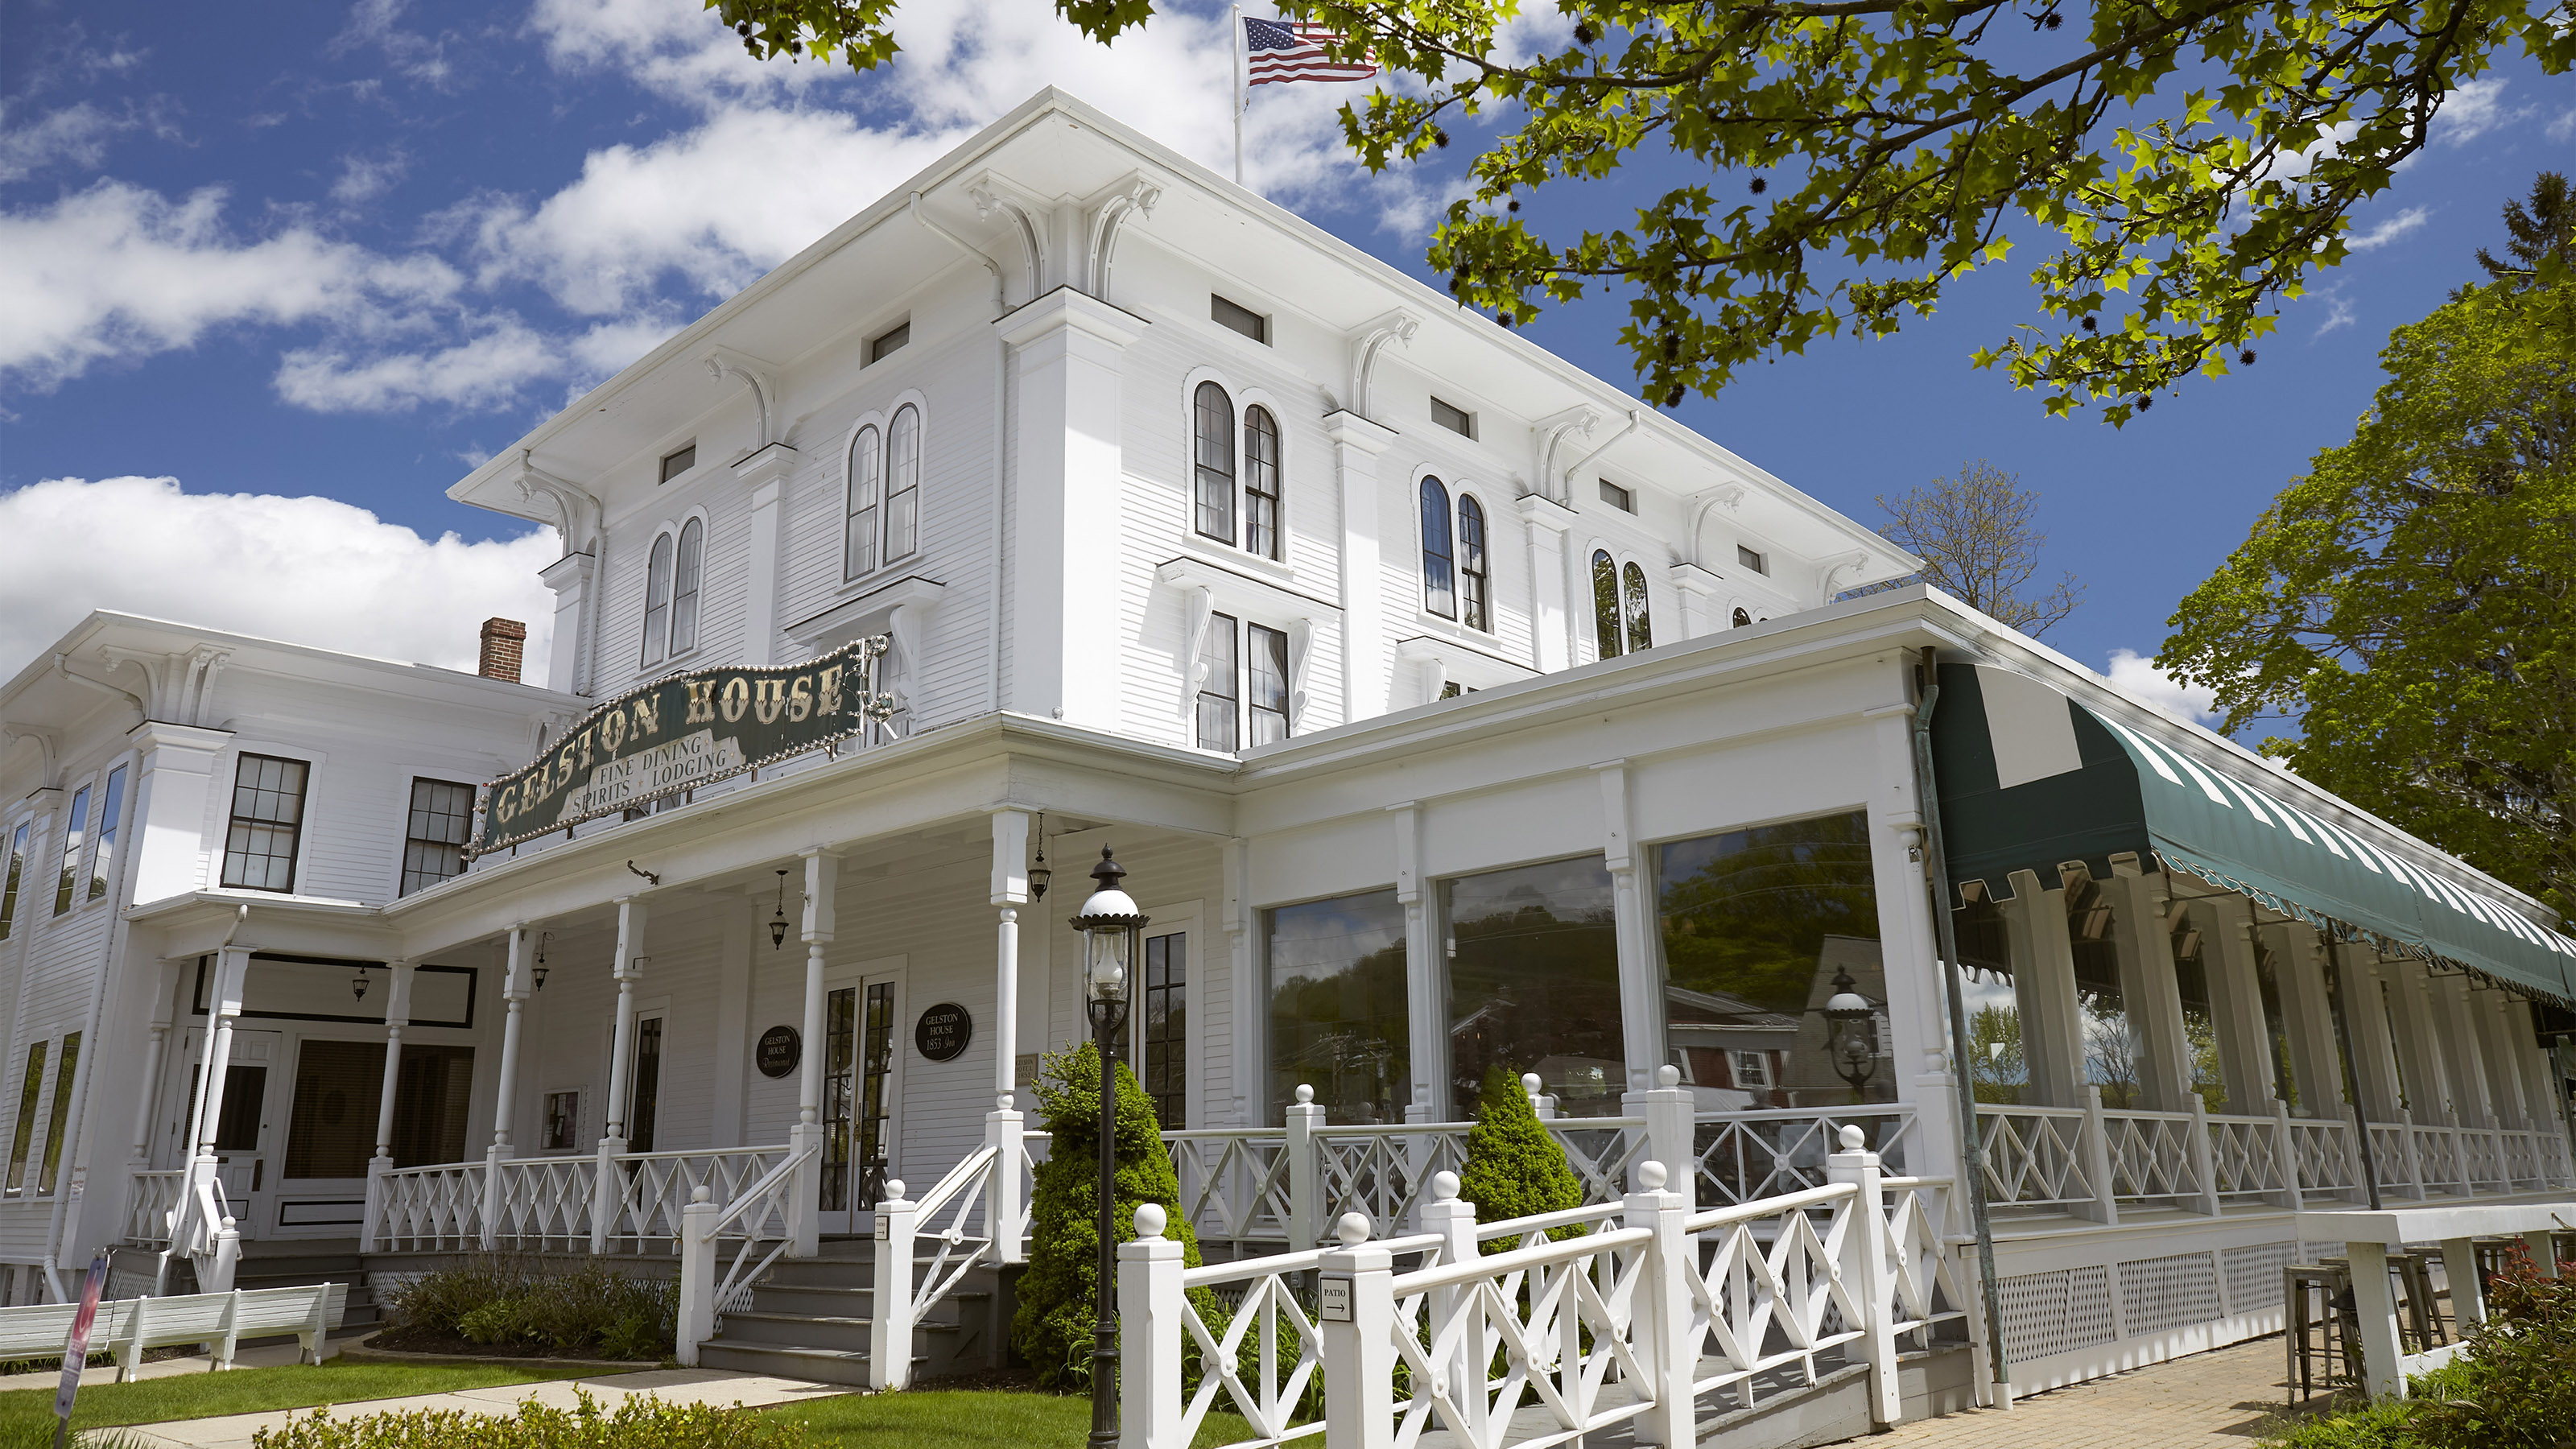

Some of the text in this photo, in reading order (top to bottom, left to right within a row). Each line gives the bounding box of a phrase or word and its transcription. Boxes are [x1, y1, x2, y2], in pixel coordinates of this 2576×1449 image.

[496, 663, 843, 825] GELSTON HOUSE
[600, 737, 701, 784] FINE DINING
[573, 749, 726, 813] SPIRITS LODGING
[926, 1013, 959, 1025] GELSTON
[930, 1025, 954, 1036] HOUSE
[765, 1034, 791, 1045] GELSTON
[927, 1038, 942, 1051] 1853
[767, 1046, 786, 1055] HOUSE
[1324, 1289, 1346, 1297] PATIO
